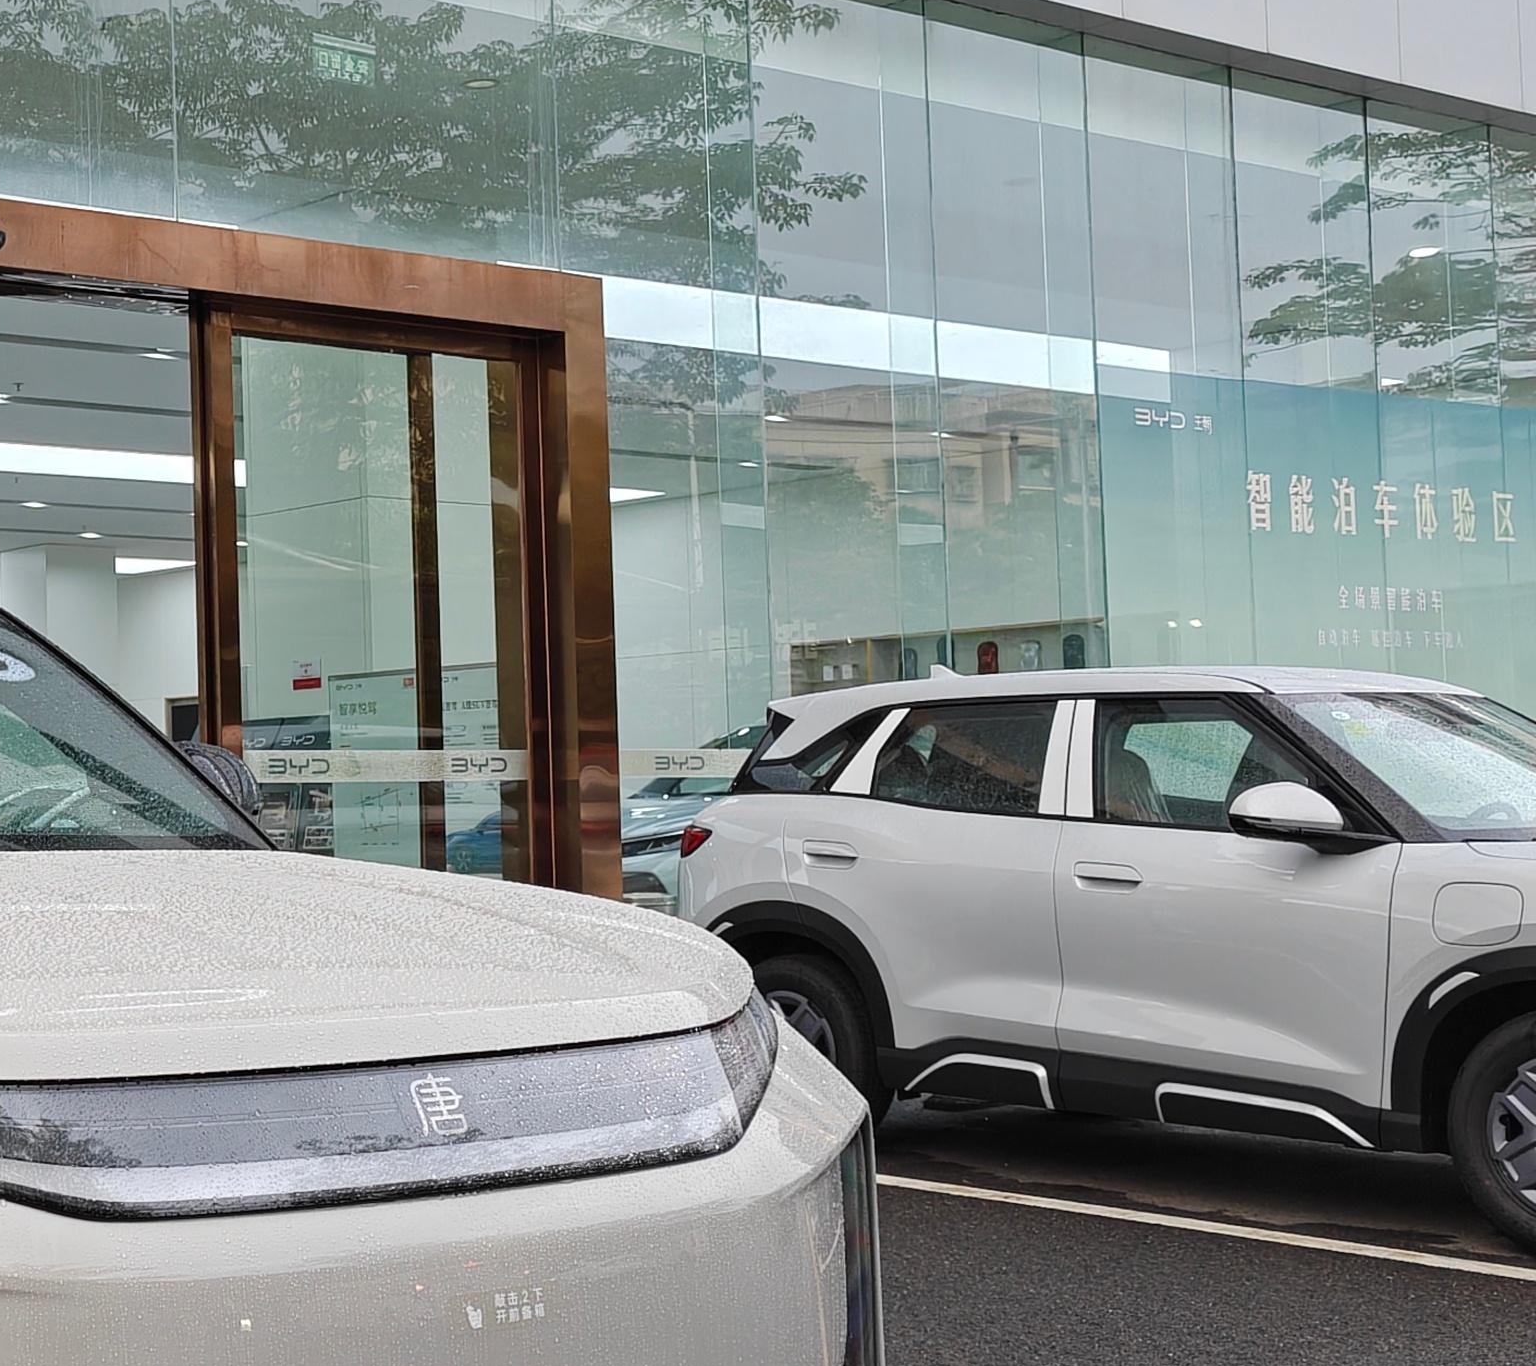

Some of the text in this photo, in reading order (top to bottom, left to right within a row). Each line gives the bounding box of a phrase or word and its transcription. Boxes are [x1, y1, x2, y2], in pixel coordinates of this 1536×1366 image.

[1134, 407, 1186, 429] BYD
[1246, 469, 1516, 544] 智能泊车体验区
[280, 735, 316, 747] BYD
[267, 758, 331, 775] BYD
[450, 756, 508, 773] BYD
[654, 755, 706, 772] BYD
[409, 1073, 467, 1137] 唐
